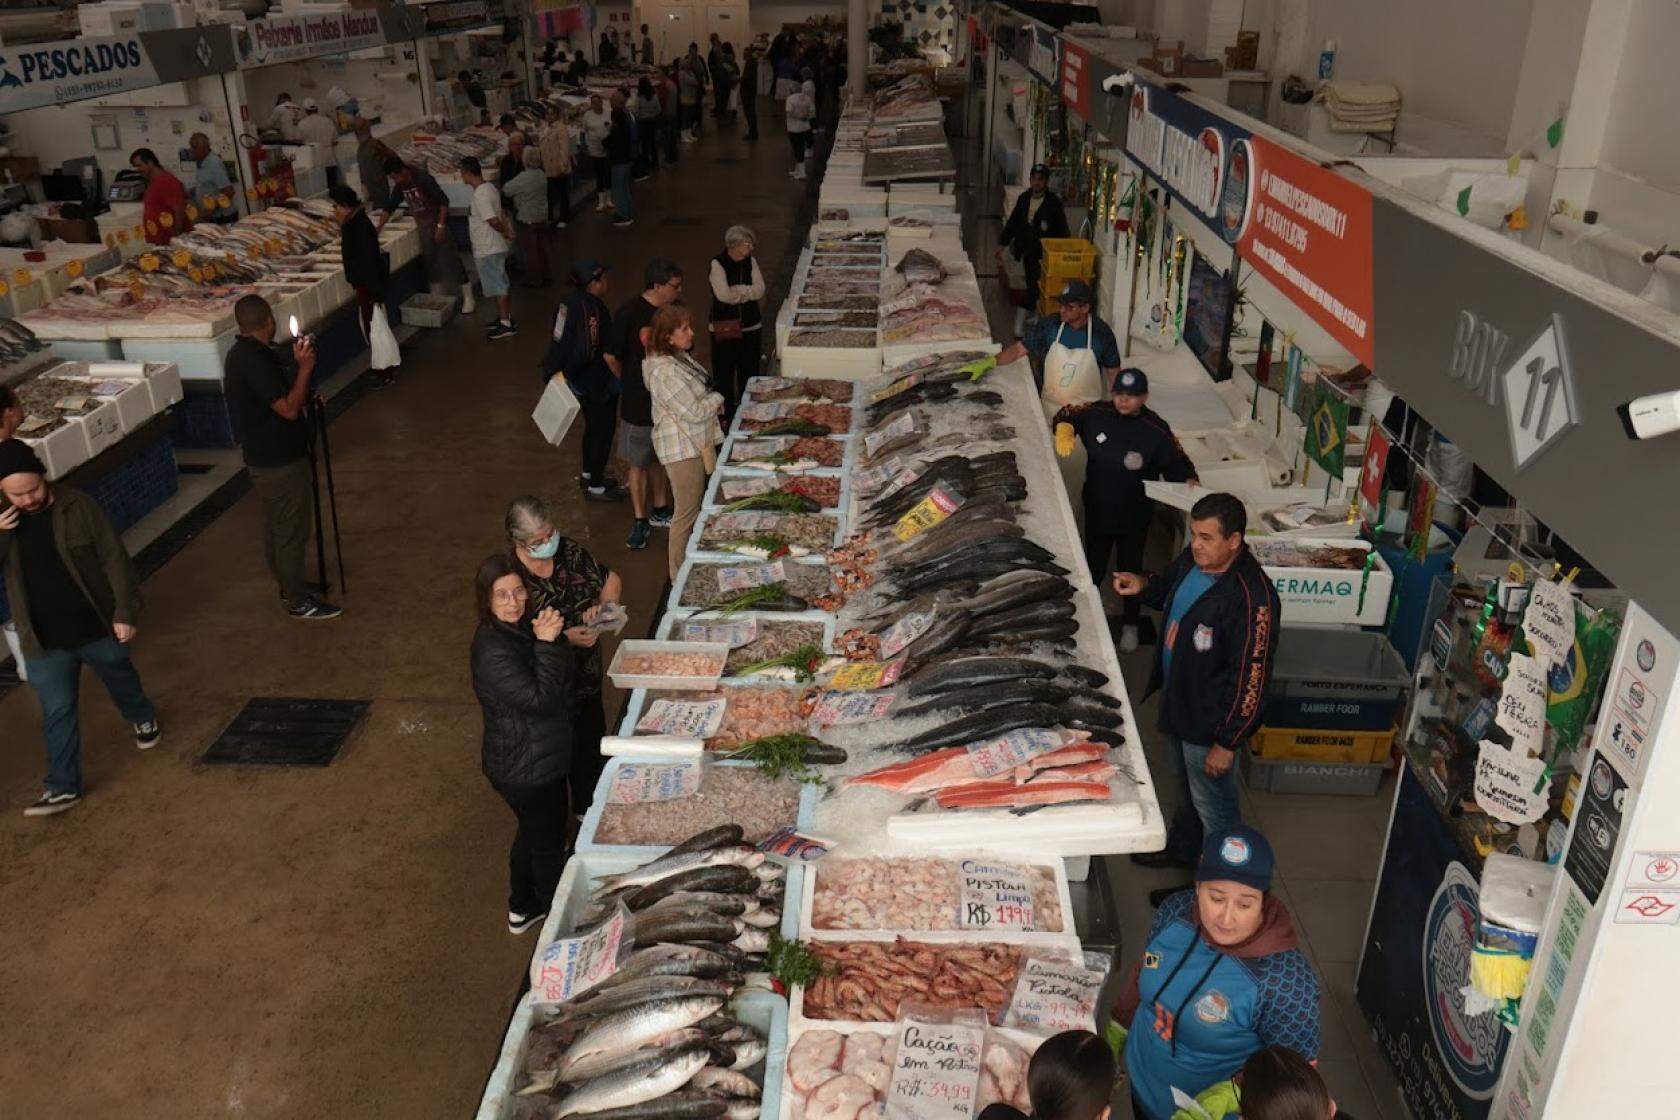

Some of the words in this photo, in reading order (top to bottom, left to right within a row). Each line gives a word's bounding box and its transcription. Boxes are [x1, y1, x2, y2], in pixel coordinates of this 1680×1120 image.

[20, 40, 141, 83] PESCADOS
[1520, 356, 1563, 441] 11
[1275, 578, 1352, 595] ERMAQ
[1284, 765, 1369, 778] BIANCHI
